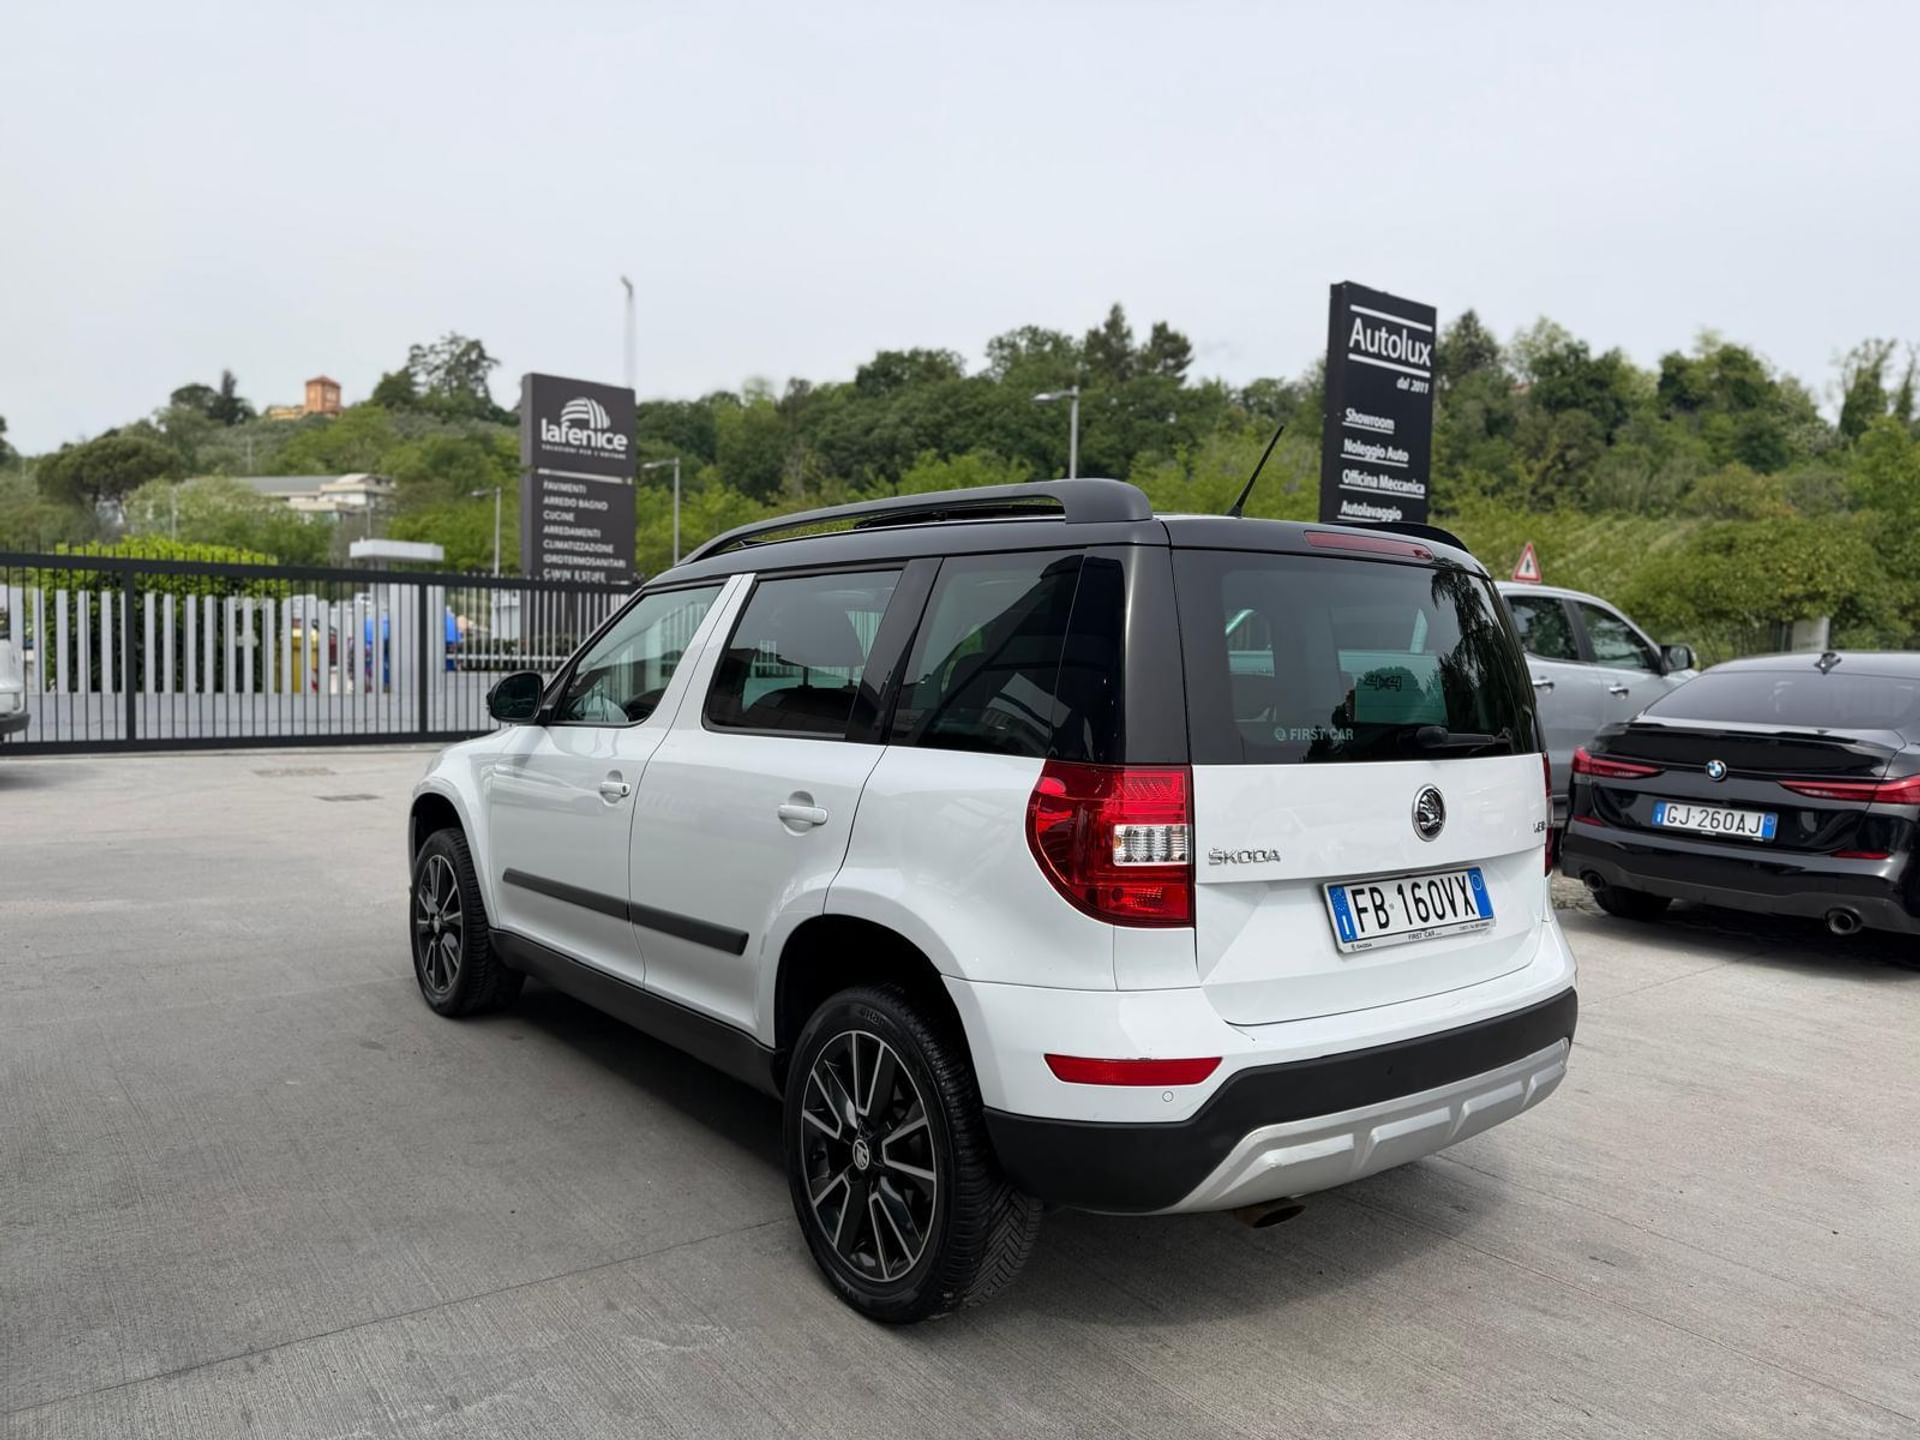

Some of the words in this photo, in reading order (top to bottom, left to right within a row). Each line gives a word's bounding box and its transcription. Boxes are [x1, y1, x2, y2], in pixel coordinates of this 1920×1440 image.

[1349, 317, 1431, 367] Autolux
[1345, 408, 1396, 430] Showroom
[541, 418, 629, 452] lafenice
[1343, 438, 1386, 461] Noleggio
[1386, 446, 1409, 463] Auto
[543, 480, 587, 494] PAVIMENTI
[1342, 469, 1378, 488] Officina
[1379, 474, 1426, 495] Meccanica
[543, 496, 577, 507] ARREDO
[578, 499, 608, 511] BAGNO
[1341, 500, 1402, 522] Autolavaggio
[543, 510, 575, 522] CUCINE
[543, 525, 601, 538] ARREDAMENTI
[543, 539, 614, 554] CLIMATIZZAZIONE
[543, 554, 626, 568] IDROTERMOSANITARI
[1290, 728, 1326, 740] FIRST
[1328, 728, 1354, 740] CAR
[1666, 805, 1691, 825] GJ
[1697, 809, 1762, 834] 260AJ
[1208, 847, 1281, 866] ŠKODA
[1350, 886, 1390, 933] FB
[1396, 875, 1477, 926] 160VX
